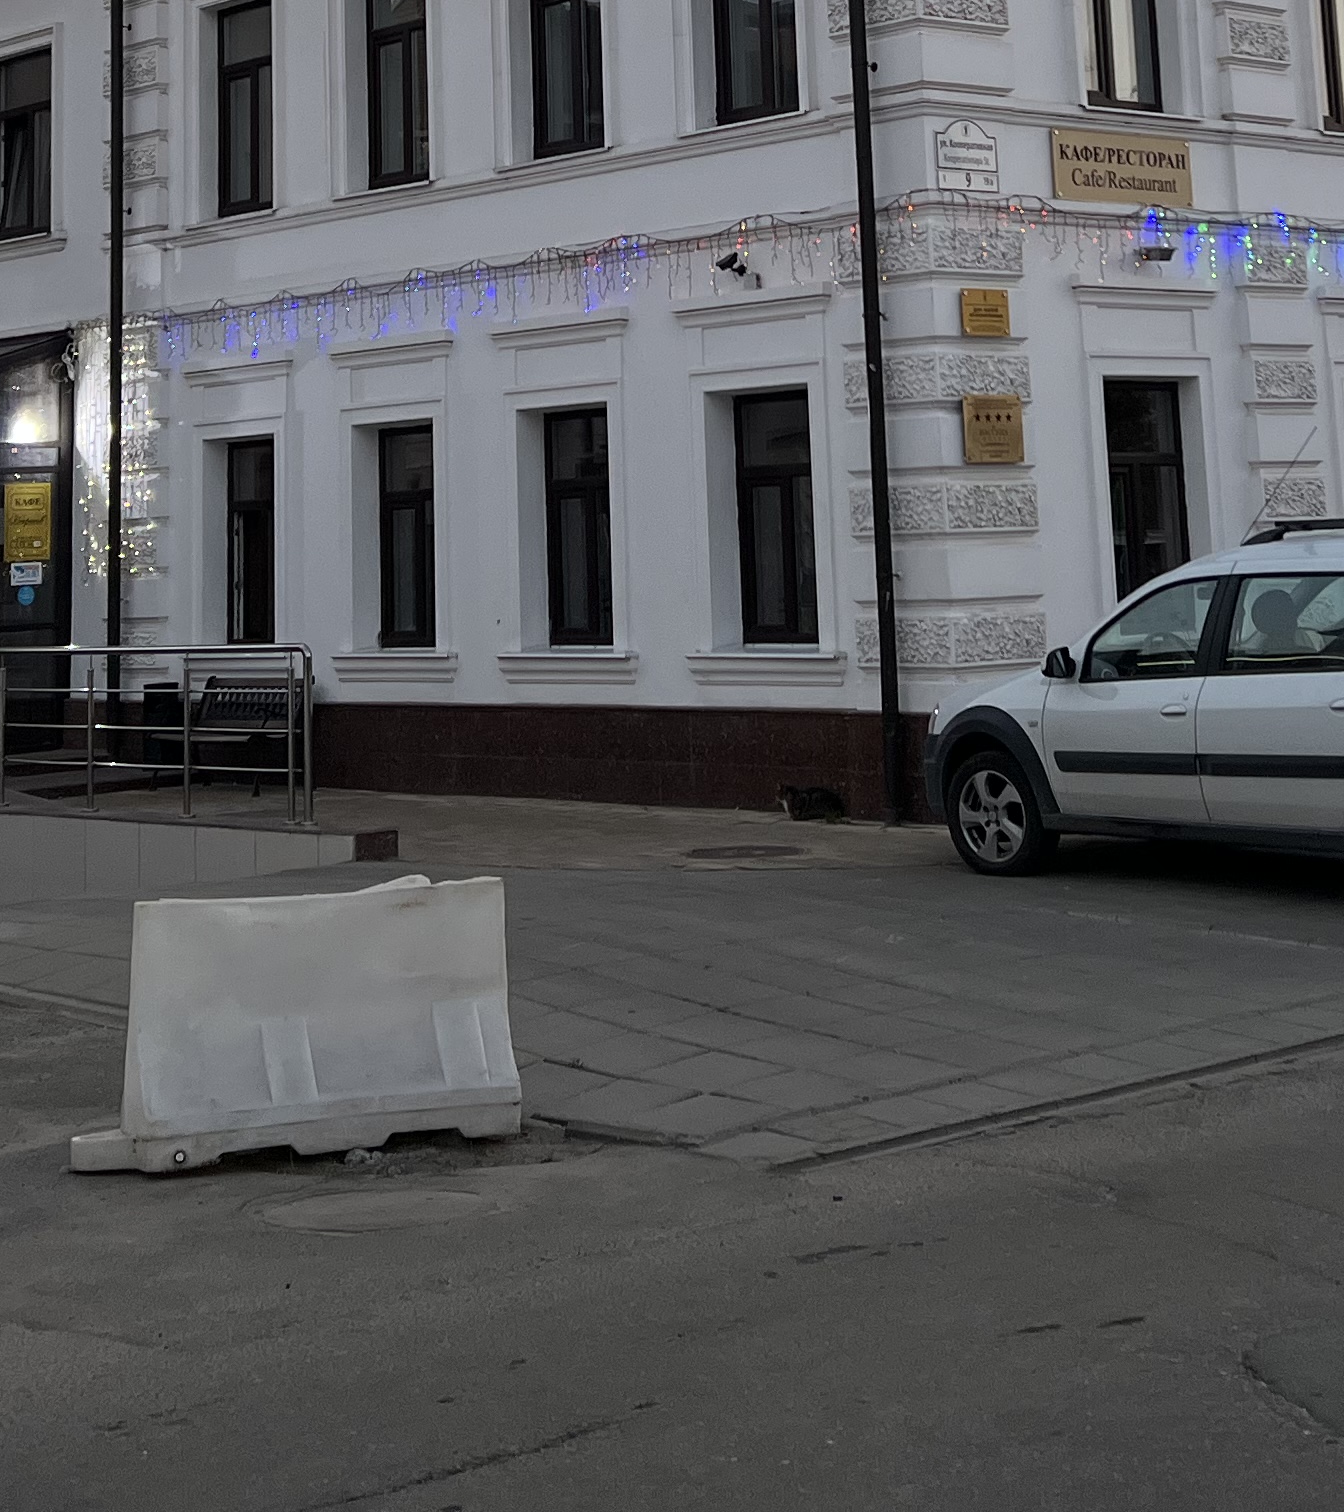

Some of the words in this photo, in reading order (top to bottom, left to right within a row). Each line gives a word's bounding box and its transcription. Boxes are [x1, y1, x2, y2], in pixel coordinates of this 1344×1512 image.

[1059, 143, 1187, 170] КАФЕ/РЕСТОРАН
[1071, 168, 1178, 194] Cafe/Restaurant
[15, 498, 41, 506] КАФЕ
